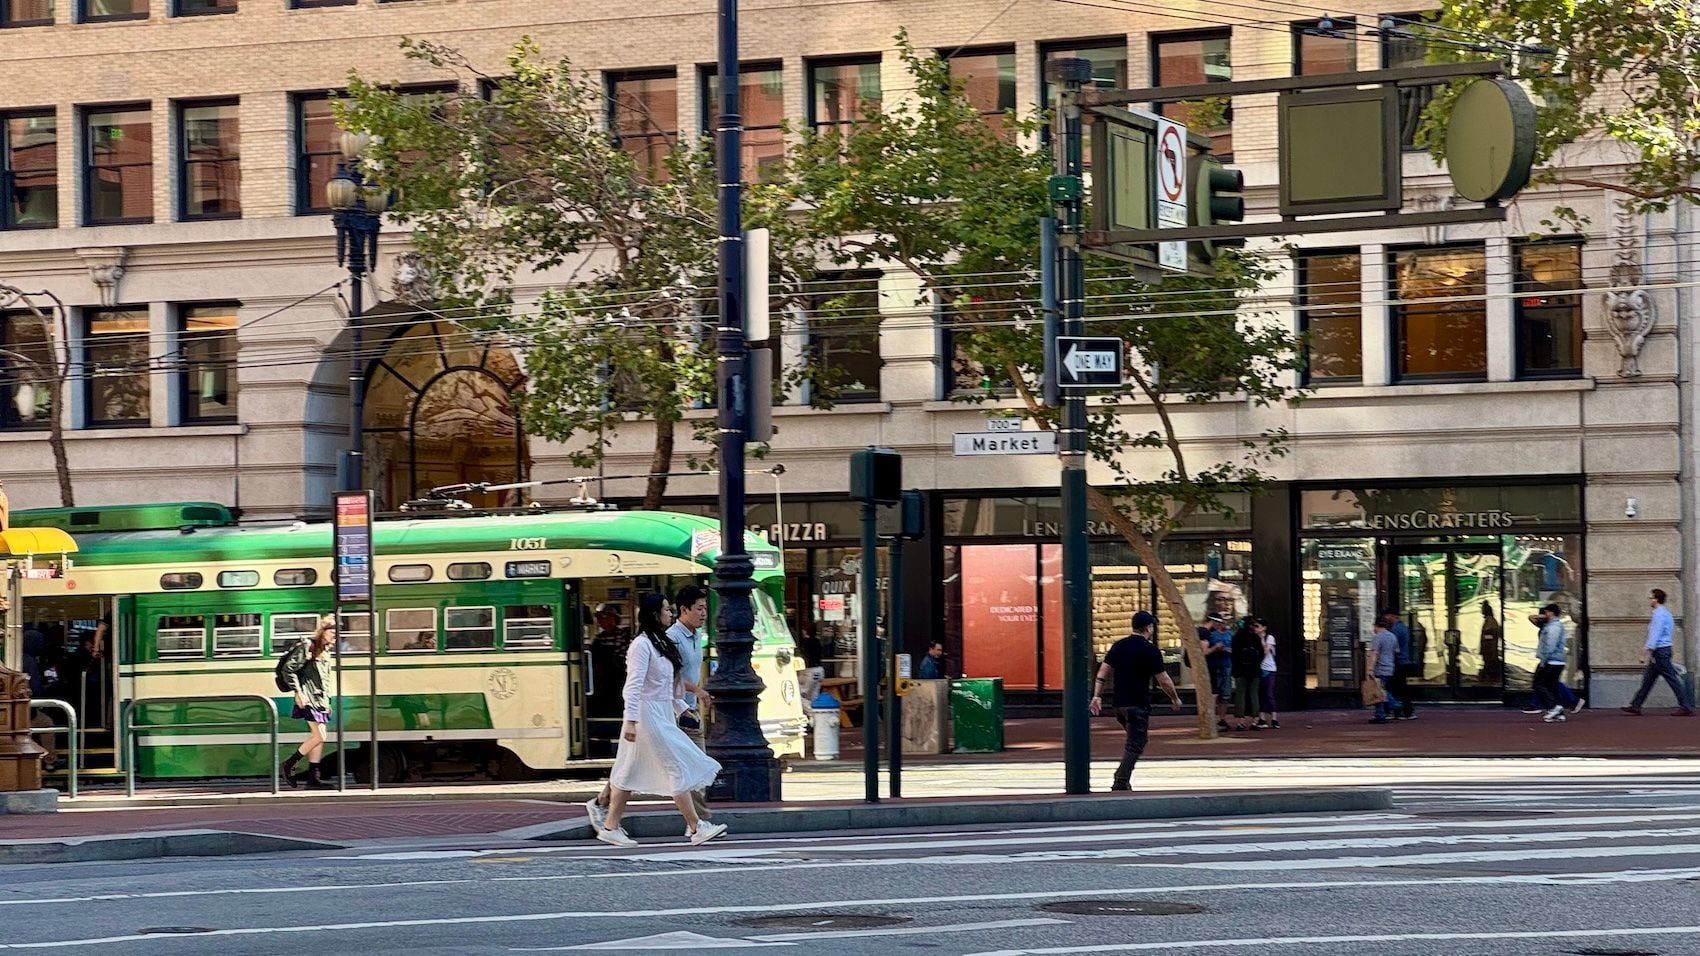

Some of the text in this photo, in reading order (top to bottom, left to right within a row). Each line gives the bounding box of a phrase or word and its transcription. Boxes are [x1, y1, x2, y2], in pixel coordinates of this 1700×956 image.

[1075, 354, 1113, 369] ONE WAY
[991, 420, 1010, 429] 700
[973, 437, 1039, 451] Market
[771, 523, 826, 541] PIZZA
[509, 537, 546, 550] 1051
[517, 563, 549, 575] MARKET
[822, 580, 852, 593] QUIK
